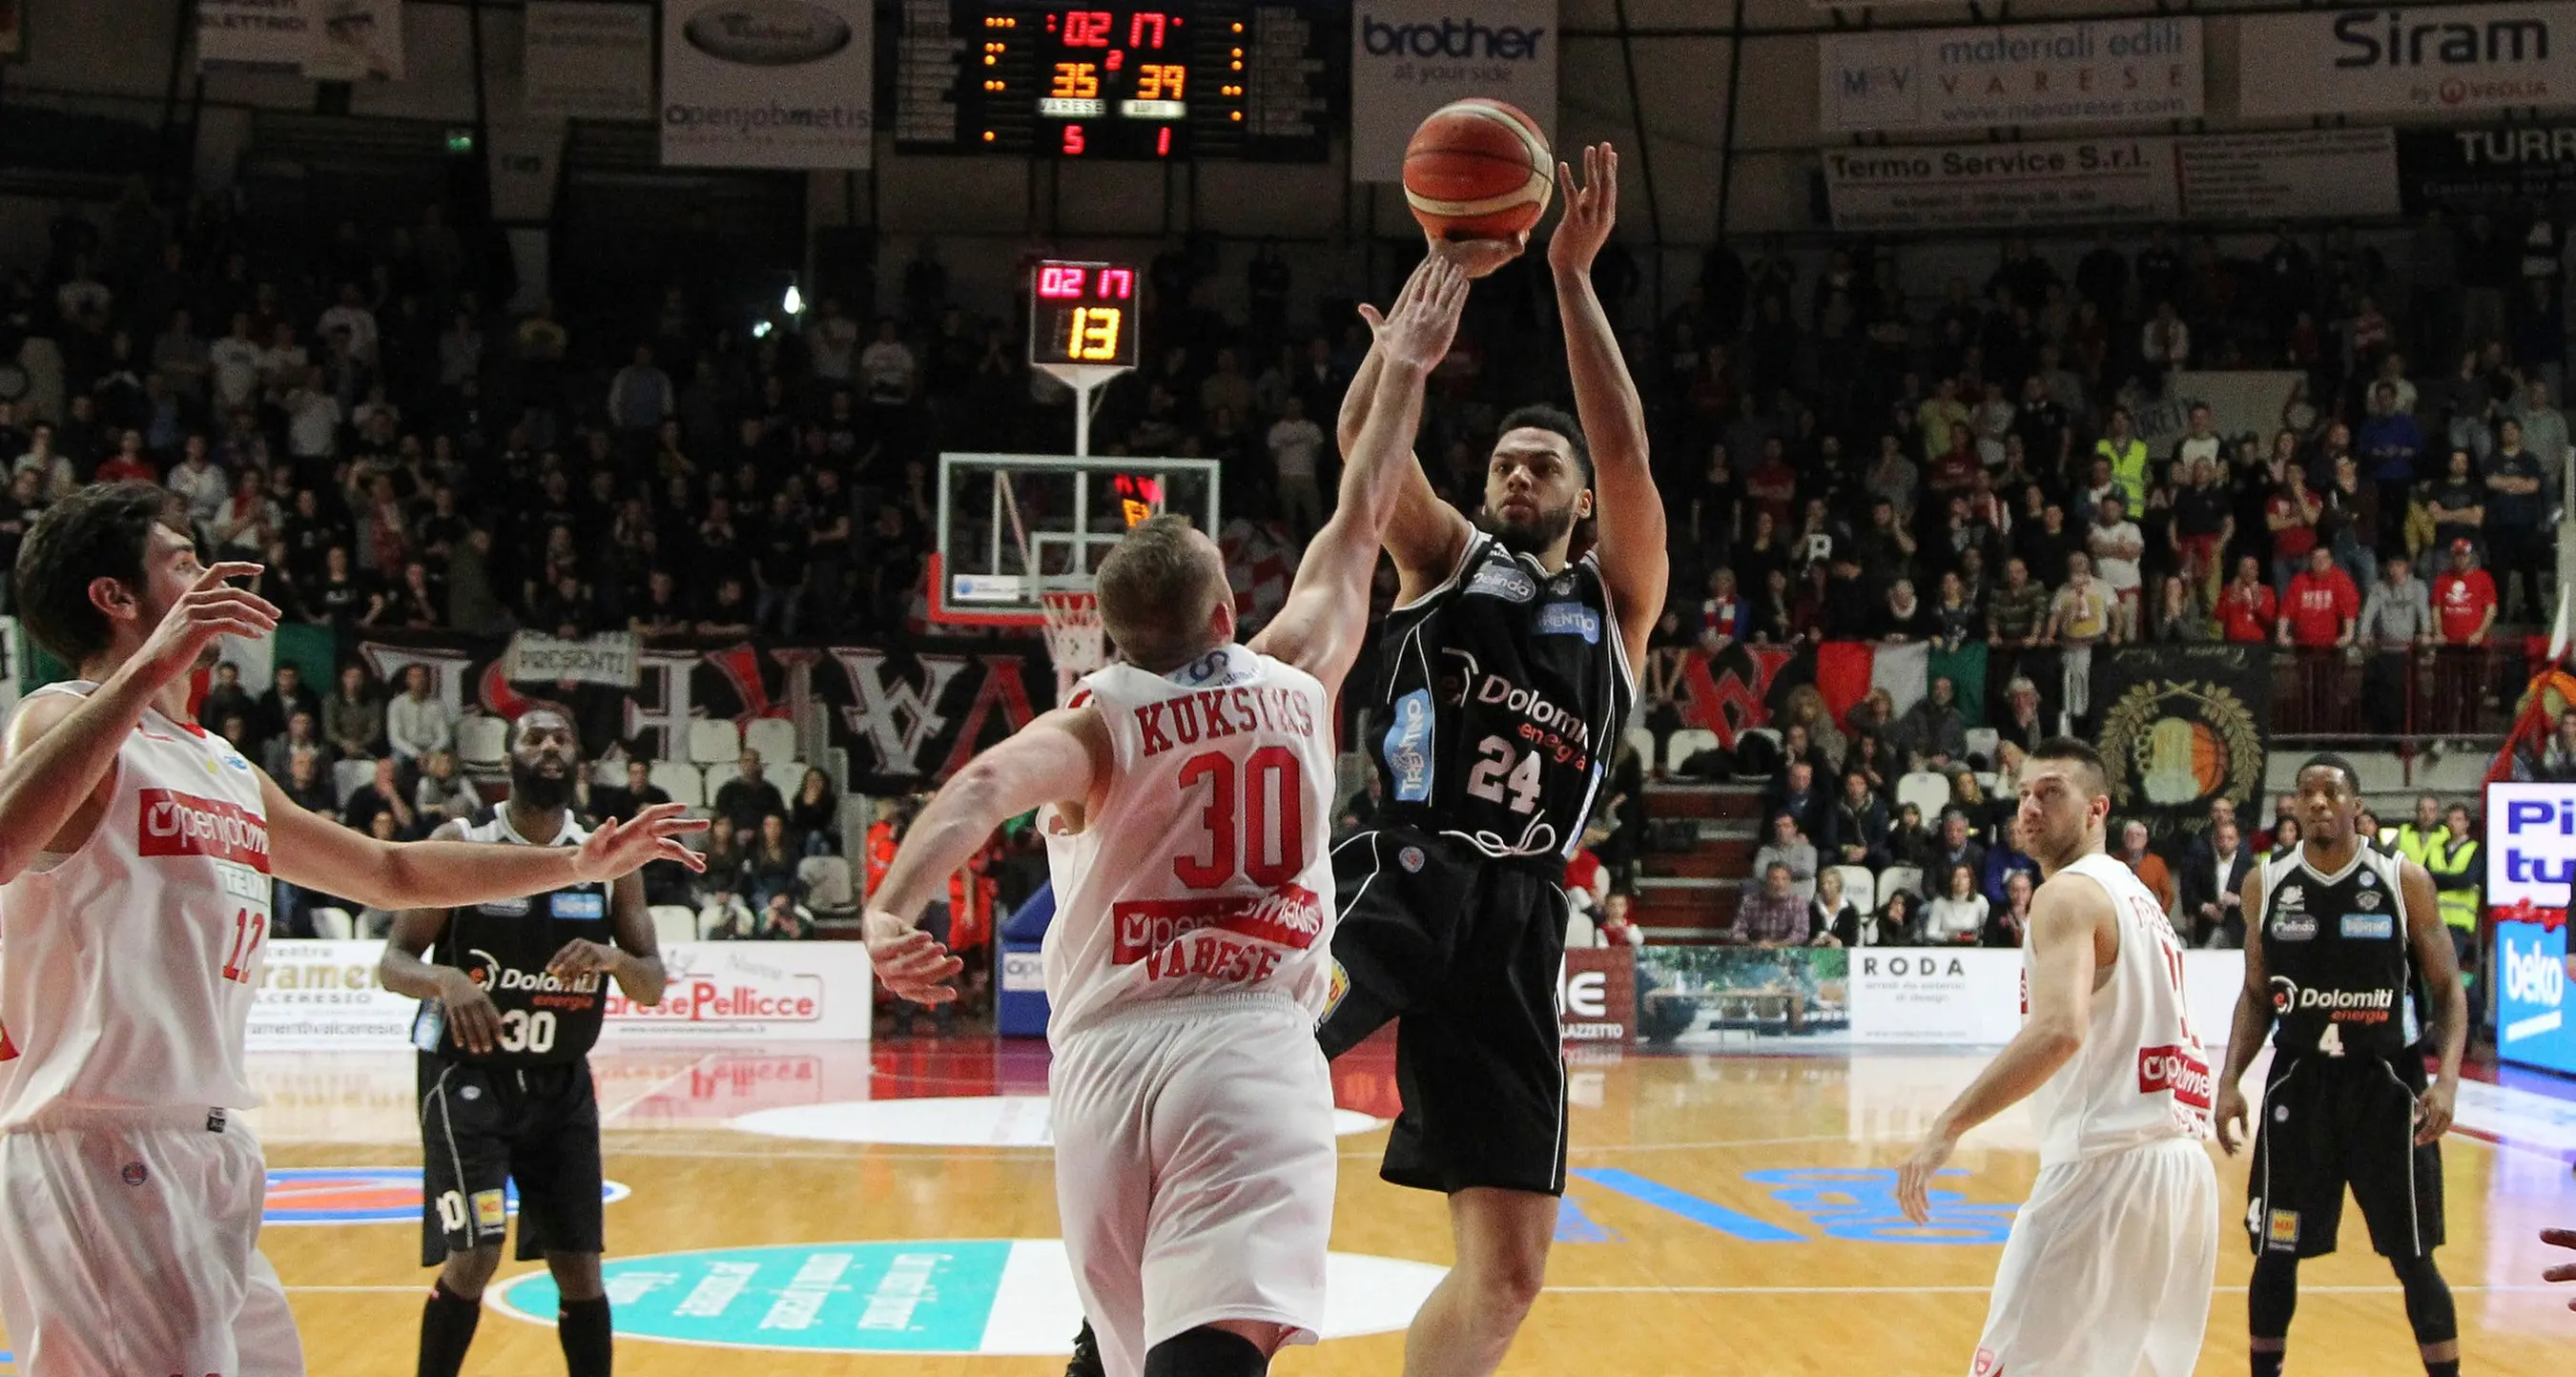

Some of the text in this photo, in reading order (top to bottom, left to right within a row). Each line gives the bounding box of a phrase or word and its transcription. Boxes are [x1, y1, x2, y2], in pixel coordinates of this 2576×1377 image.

[1362, 15, 1544, 60] brother
[1939, 22, 2183, 64] materiali edili
[2333, 11, 2549, 69] Siram
[1050, 63, 1100, 98] 35
[1135, 64, 1186, 100] 39
[1393, 64, 1514, 84] at your side
[1939, 63, 2184, 95] VARESE
[1040, 99, 1105, 113] VARESE
[1061, 125, 1085, 154] 5
[1157, 127, 1171, 155] 1
[2455, 129, 2576, 165] TURR
[1830, 144, 2151, 180] Termo Service S.r.l.
[1039, 267, 1134, 299] 02 17
[1067, 306, 1122, 360] 13
[1134, 687, 1314, 757] KUKSIKS
[1467, 734, 1542, 815] 24
[1173, 746, 1304, 890] 30
[221, 907, 265, 984] 12
[1146, 937, 1282, 982] VARESE
[1864, 956, 1965, 976] RODA
[2505, 938, 2564, 1007] beko
[2299, 988, 2394, 1008] Dolomiti
[502, 1009, 558, 1054] 30
[2330, 1009, 2390, 1024] energia
[2318, 1022, 2346, 1058] 4
